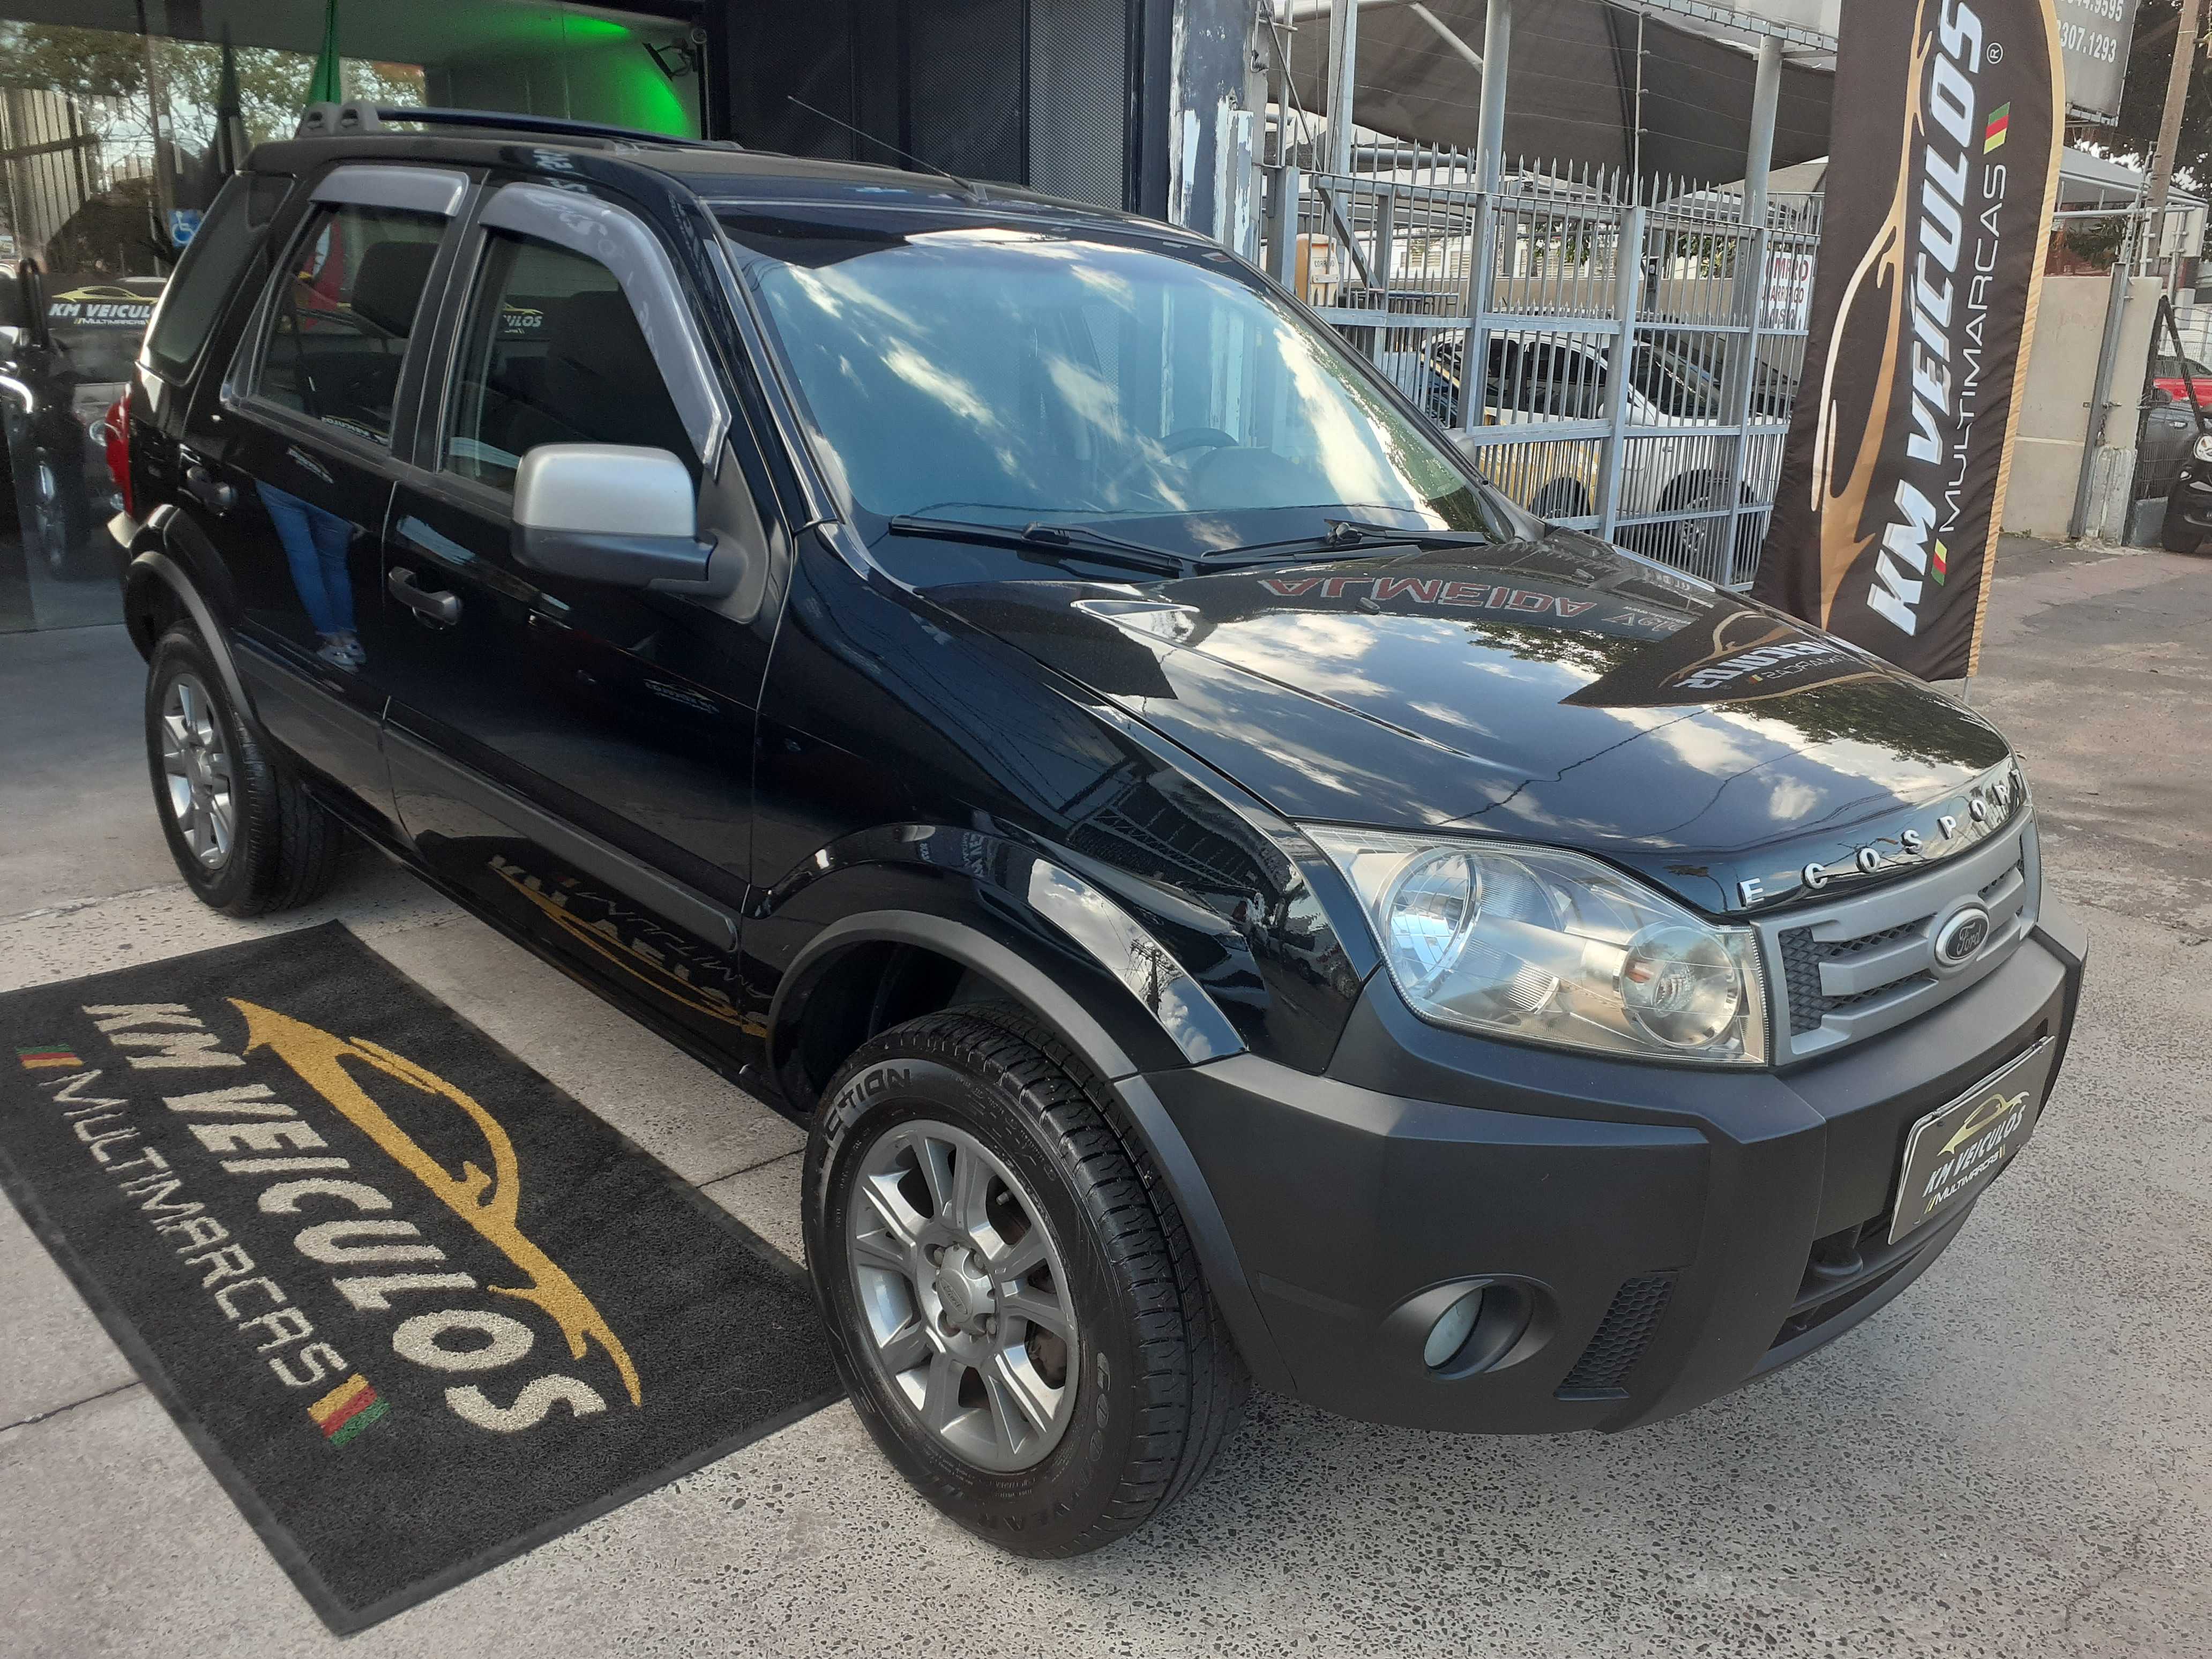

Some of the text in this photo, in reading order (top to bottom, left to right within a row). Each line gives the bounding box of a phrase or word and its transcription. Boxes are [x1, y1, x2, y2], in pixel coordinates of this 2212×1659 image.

[48, 303, 153, 318] KM VEICUL
[1938, 163, 2006, 534] MULTIMARCAS
[1866, 477, 1937, 637] KM
[1956, 922, 1982, 956] Ford
[38, 1069, 348, 1387] MULTIMARCAS
[81, 1002, 607, 1434] KM VEICULOS
[1922, 1104, 2026, 1198] KM VEICULOS
